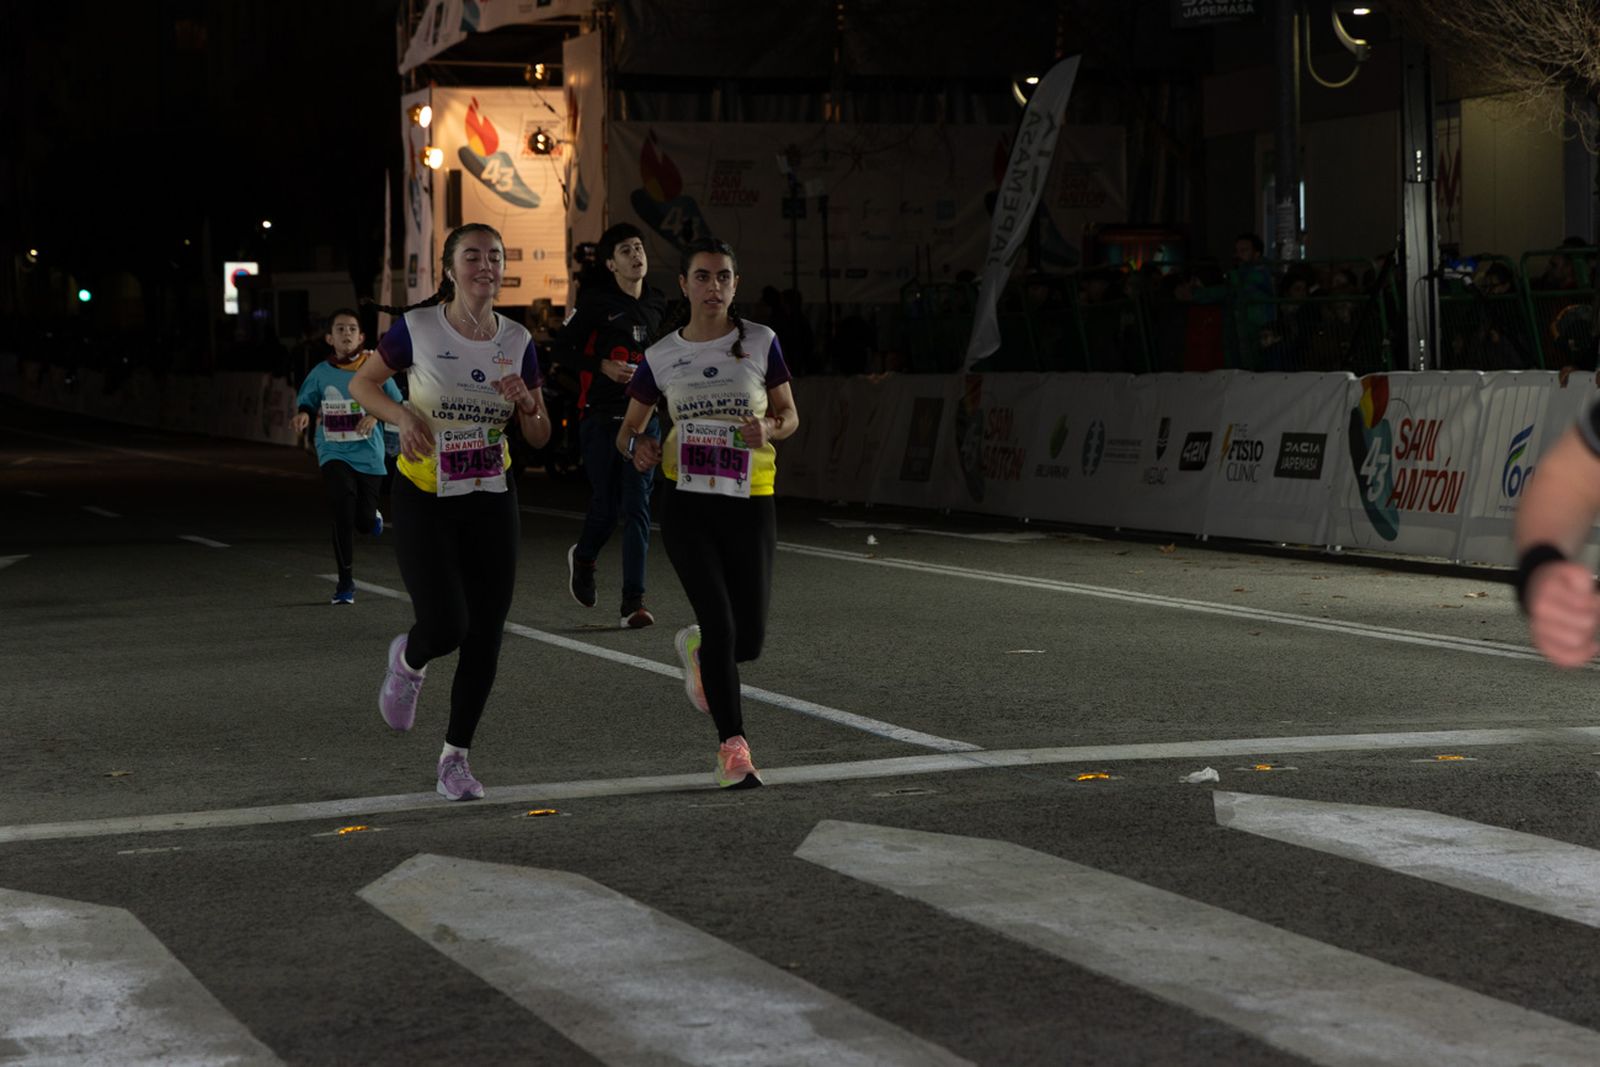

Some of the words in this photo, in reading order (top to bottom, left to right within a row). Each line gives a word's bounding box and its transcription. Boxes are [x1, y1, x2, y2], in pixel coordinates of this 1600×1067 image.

[1182, 5, 1256, 18] JAPEMASA
[481, 159, 514, 192] 43
[432, 411, 454, 420] LOS
[442, 402, 480, 413] SANTA
[676, 400, 713, 413] SANTA
[735, 398, 749, 407] DE
[445, 442, 461, 451] SAN
[454, 432, 477, 440] NOCHE
[1395, 418, 1443, 462] SAN
[689, 445, 743, 472] 15495
[1183, 440, 1209, 462] 42K
[1228, 439, 1265, 462] FISIO
[1226, 463, 1261, 483] CLINIC
[1360, 437, 1391, 503] 43
[1385, 456, 1465, 513] ANTÓN
